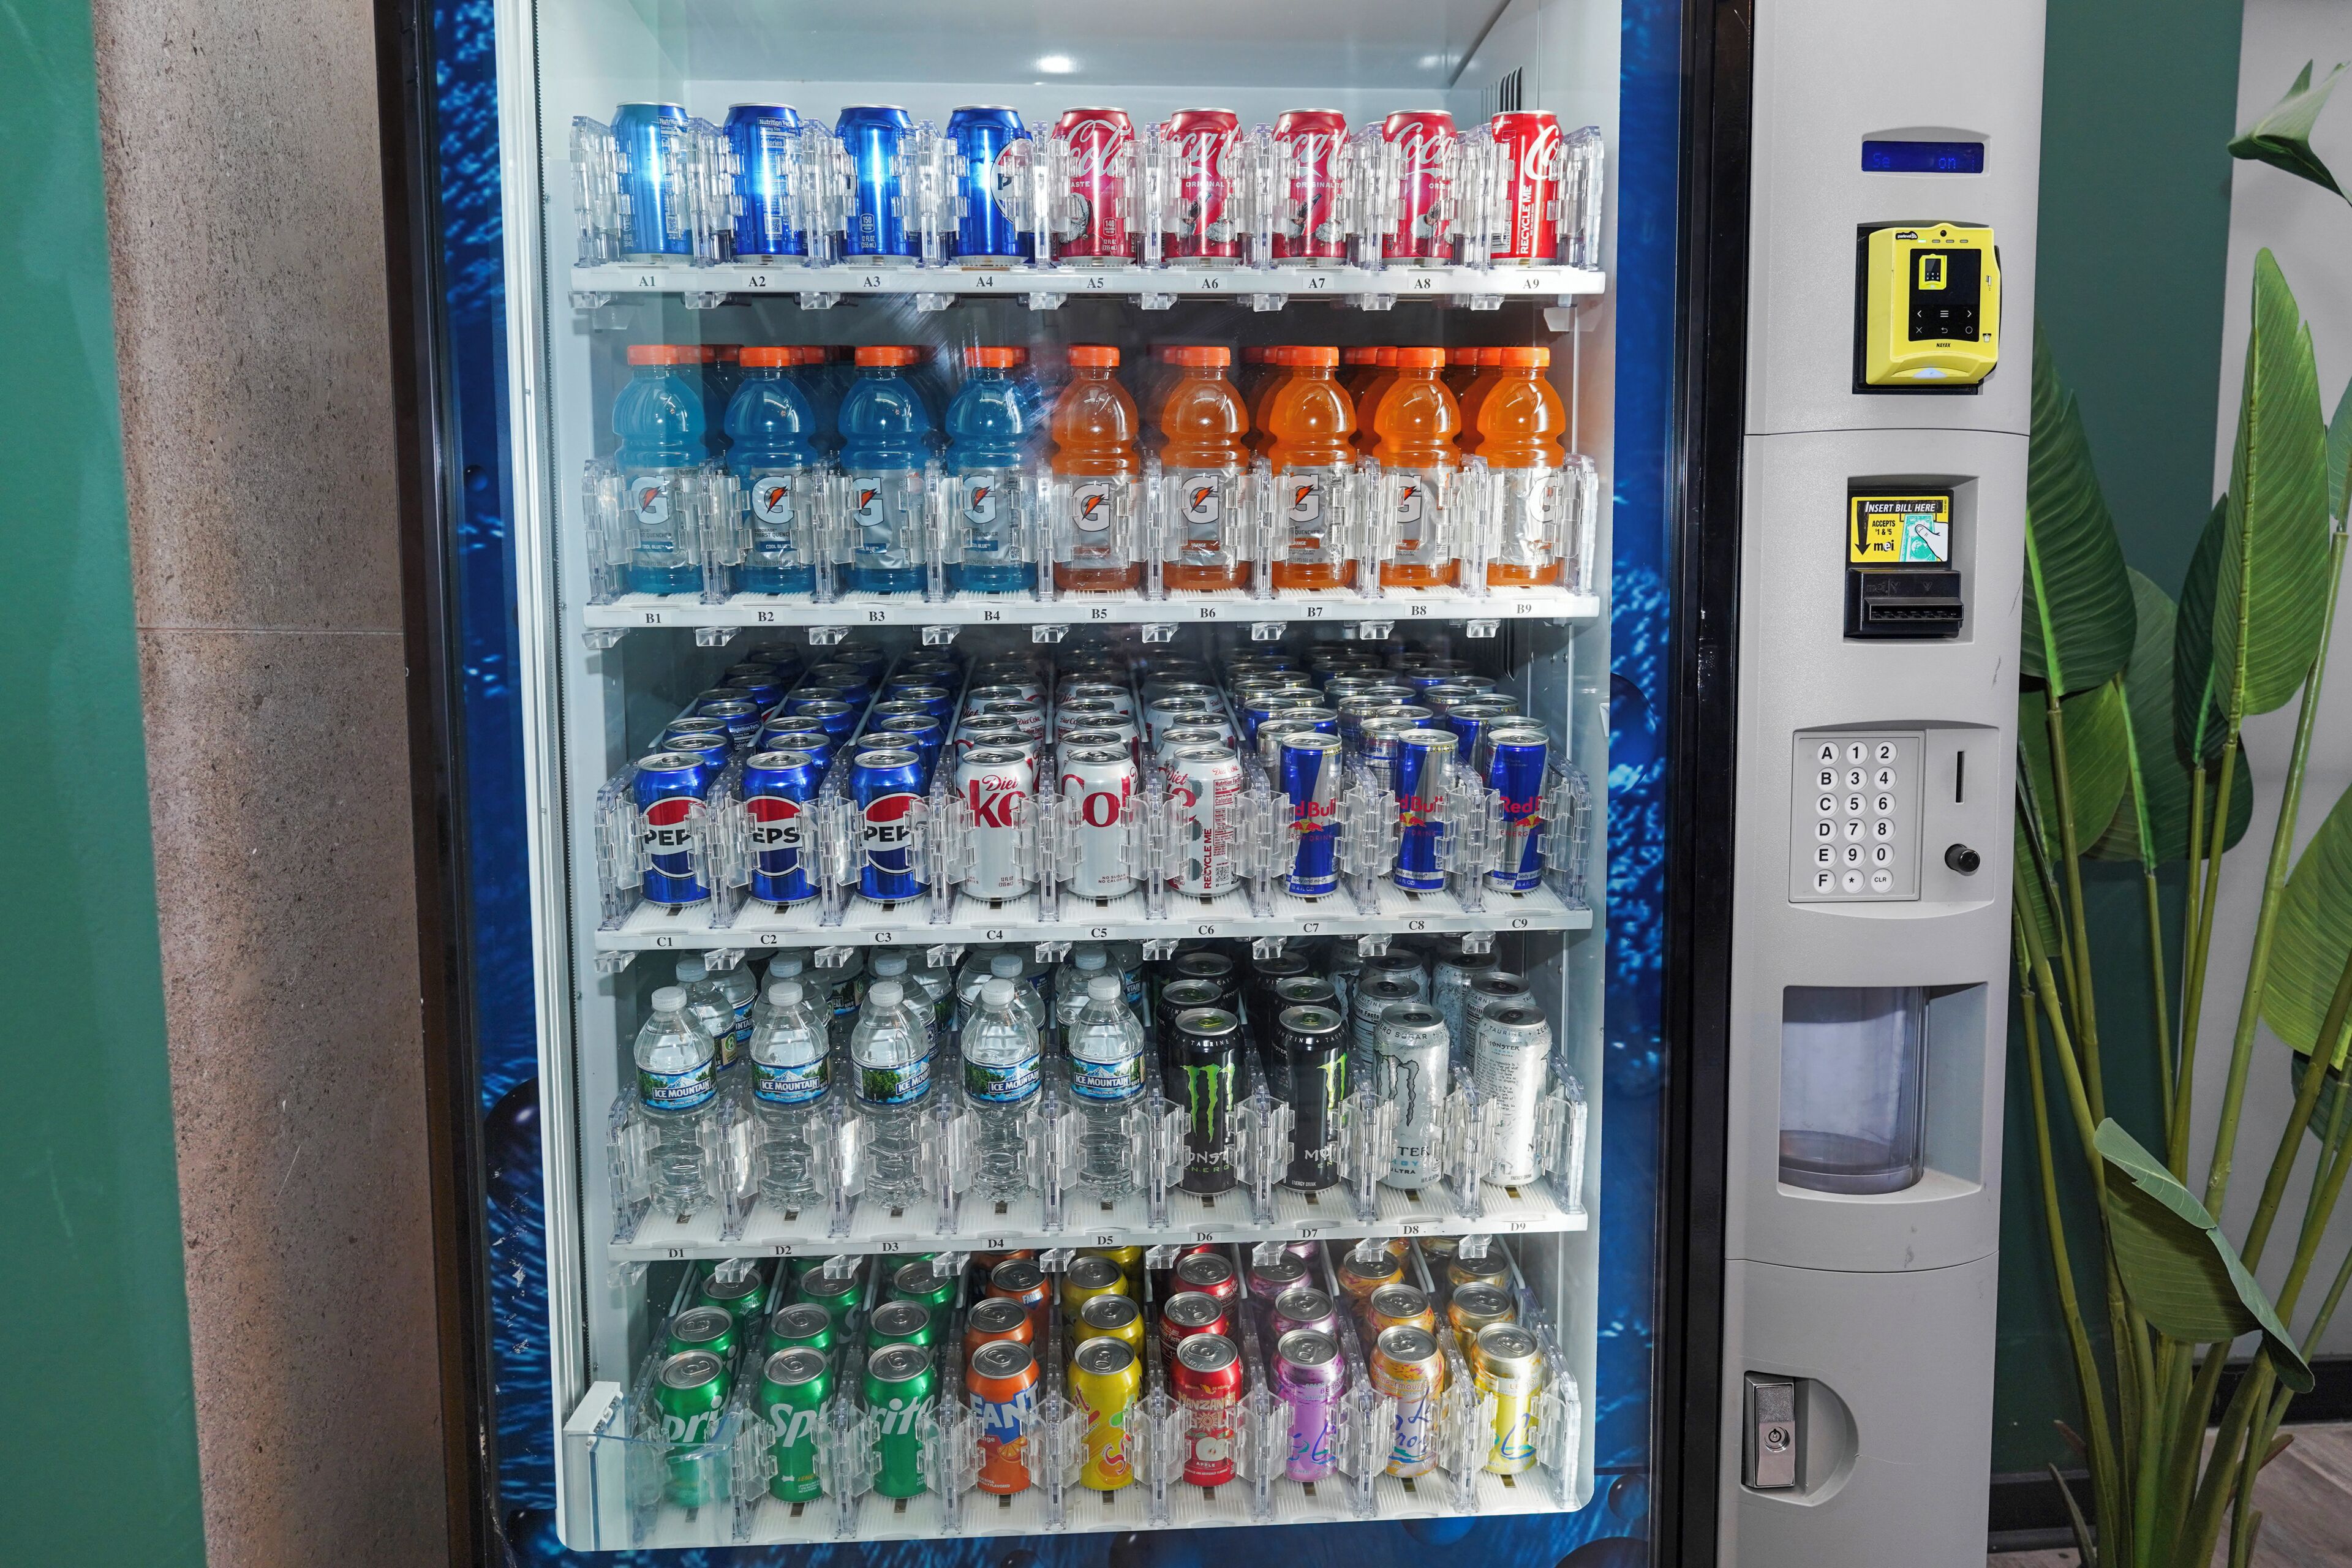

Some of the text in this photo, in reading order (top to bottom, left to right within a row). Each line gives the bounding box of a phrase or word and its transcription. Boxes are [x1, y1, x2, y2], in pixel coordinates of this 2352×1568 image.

[1520, 185, 1532, 254] RECYCLE ME
[639, 276, 655, 286] A1
[749, 276, 765, 287] A2
[864, 276, 880, 287] A3
[976, 276, 993, 287] A4
[1087, 278, 1103, 288] A5
[1202, 279, 1218, 288] A6
[1309, 278, 1325, 288] A7
[1415, 279, 1430, 288] A8
[1523, 279, 1539, 288] A9
[631, 475, 669, 525] G
[752, 475, 794, 525] G
[962, 475, 997, 525] G
[1181, 474, 1219, 524] G
[1289, 473, 1320, 522] G
[1072, 483, 1110, 532] G
[1865, 502, 1936, 513] INSERT BILL HERE
[1874, 540, 1894, 551] mei
[1092, 609, 1107, 619] B5
[1200, 608, 1215, 617] B6
[1308, 608, 1322, 617] B7
[1412, 606, 1426, 615] B8
[1517, 605, 1531, 613] B9
[646, 614, 661, 623] B1
[758, 612, 774, 621] B2
[869, 611, 884, 621] B3
[985, 611, 1000, 620] B4
[1822, 747, 1832, 759] A
[1853, 747, 1858, 758] 1
[1880, 746, 1889, 758] 2
[982, 775, 1018, 792] Diet
[1822, 772, 1831, 785] B
[1851, 772, 1859, 785] 3
[1880, 772, 1888, 784] 4
[1501, 796, 1533, 813] Red
[1820, 797, 1831, 810] C
[1850, 798, 1858, 810] 5
[1879, 797, 1887, 810] 6
[1820, 823, 1830, 835] D
[1850, 823, 1858, 835] 7
[1878, 823, 1886, 835] 8
[1204, 828, 1212, 889] RECYCLE ME
[1819, 849, 1828, 861] E
[1849, 848, 1856, 861] 9
[1877, 848, 1885, 861] 0
[1819, 874, 1828, 886] F
[1303, 924, 1319, 932] C7
[1409, 921, 1424, 930] C8
[1512, 919, 1527, 928] C9
[987, 930, 1003, 940] C4
[1091, 929, 1107, 937] C5
[1199, 925, 1214, 935] C6
[657, 937, 672, 946] C1
[761, 935, 777, 944] C2
[875, 933, 891, 942] C3
[1489, 1025, 1523, 1038] TAURINE
[761, 1080, 773, 1090] ICE
[775, 1079, 818, 1091] MOUNTAIN
[991, 1070, 1039, 1091] ICE MOUNTAIN
[1076, 1075, 1129, 1087] ICE MOUNTAIN
[654, 1080, 710, 1098] ICE MOUNTAIN
[899, 1081, 910, 1092] ICE
[1404, 1226, 1419, 1234] D8
[1510, 1223, 1526, 1232] D9
[1197, 1232, 1212, 1241] D6
[1302, 1229, 1318, 1238] D7
[989, 1239, 1004, 1248] D4
[1098, 1236, 1112, 1245] D5
[669, 1248, 684, 1257] D1
[775, 1246, 791, 1254] D2
